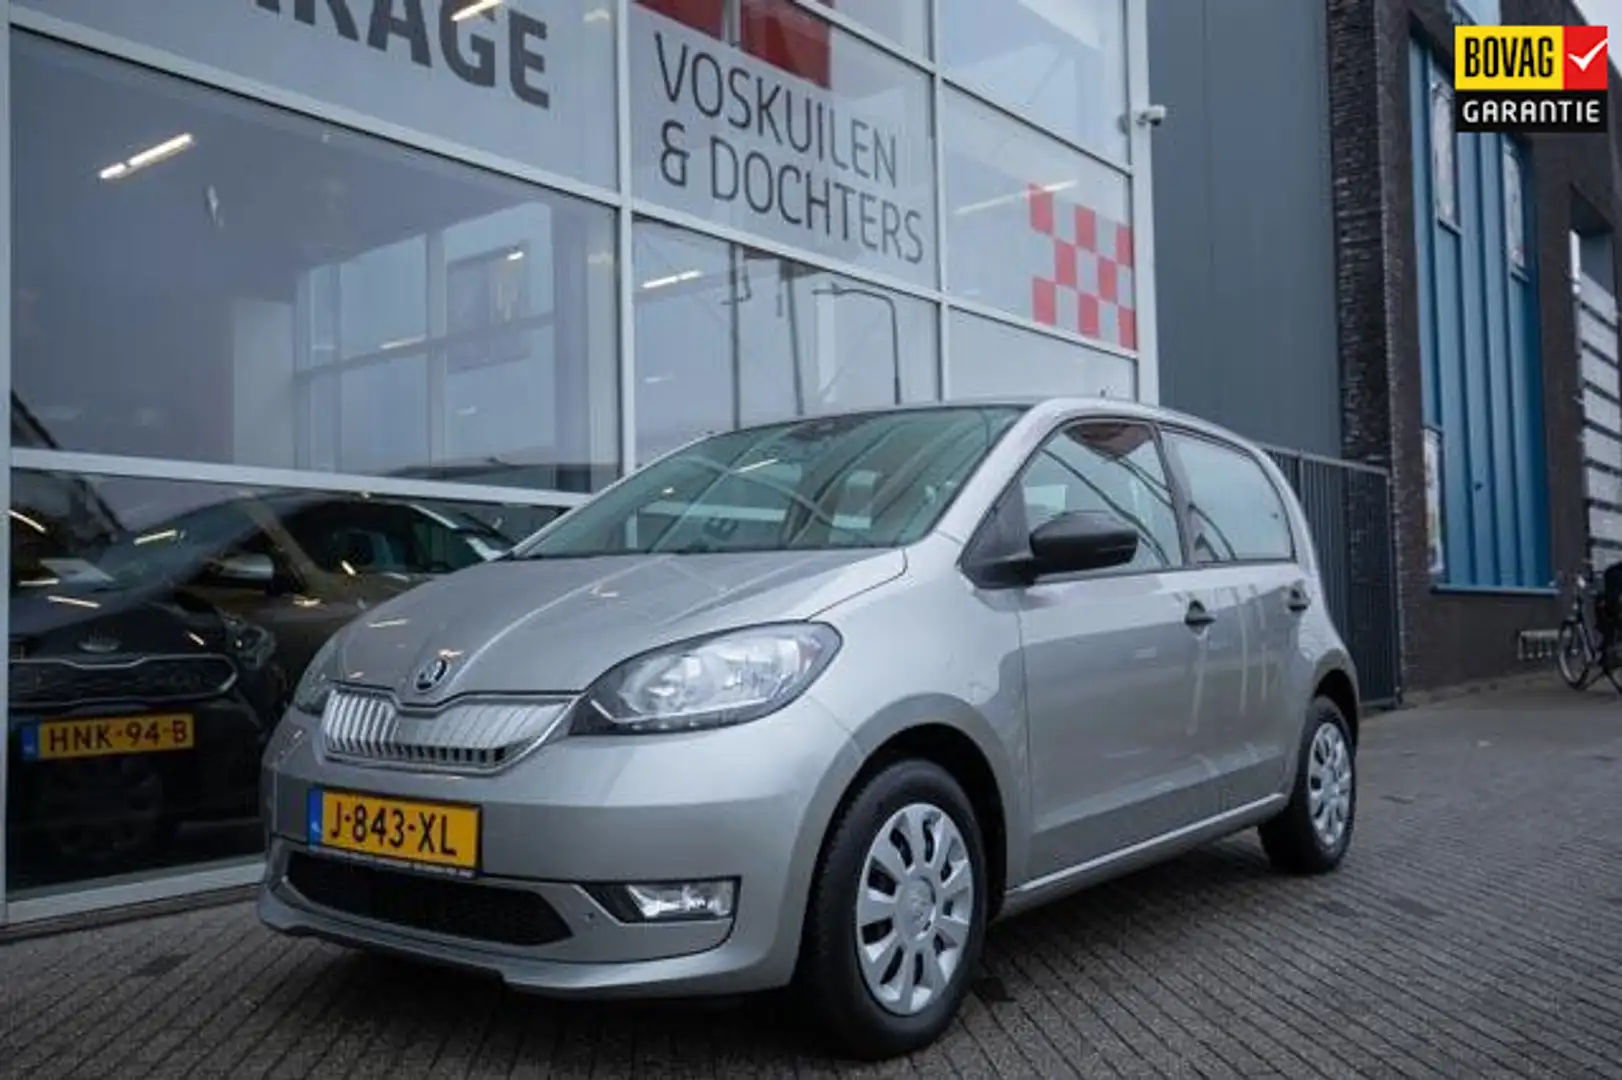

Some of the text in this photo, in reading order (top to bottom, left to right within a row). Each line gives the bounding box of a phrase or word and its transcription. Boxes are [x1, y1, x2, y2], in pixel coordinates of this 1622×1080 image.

[655, 31, 897, 188] VOSKUILEN
[659, 119, 924, 265] & DOCHTERS
[50, 719, 188, 751] HNK-94-B
[330, 801, 457, 856] J-843-XL
